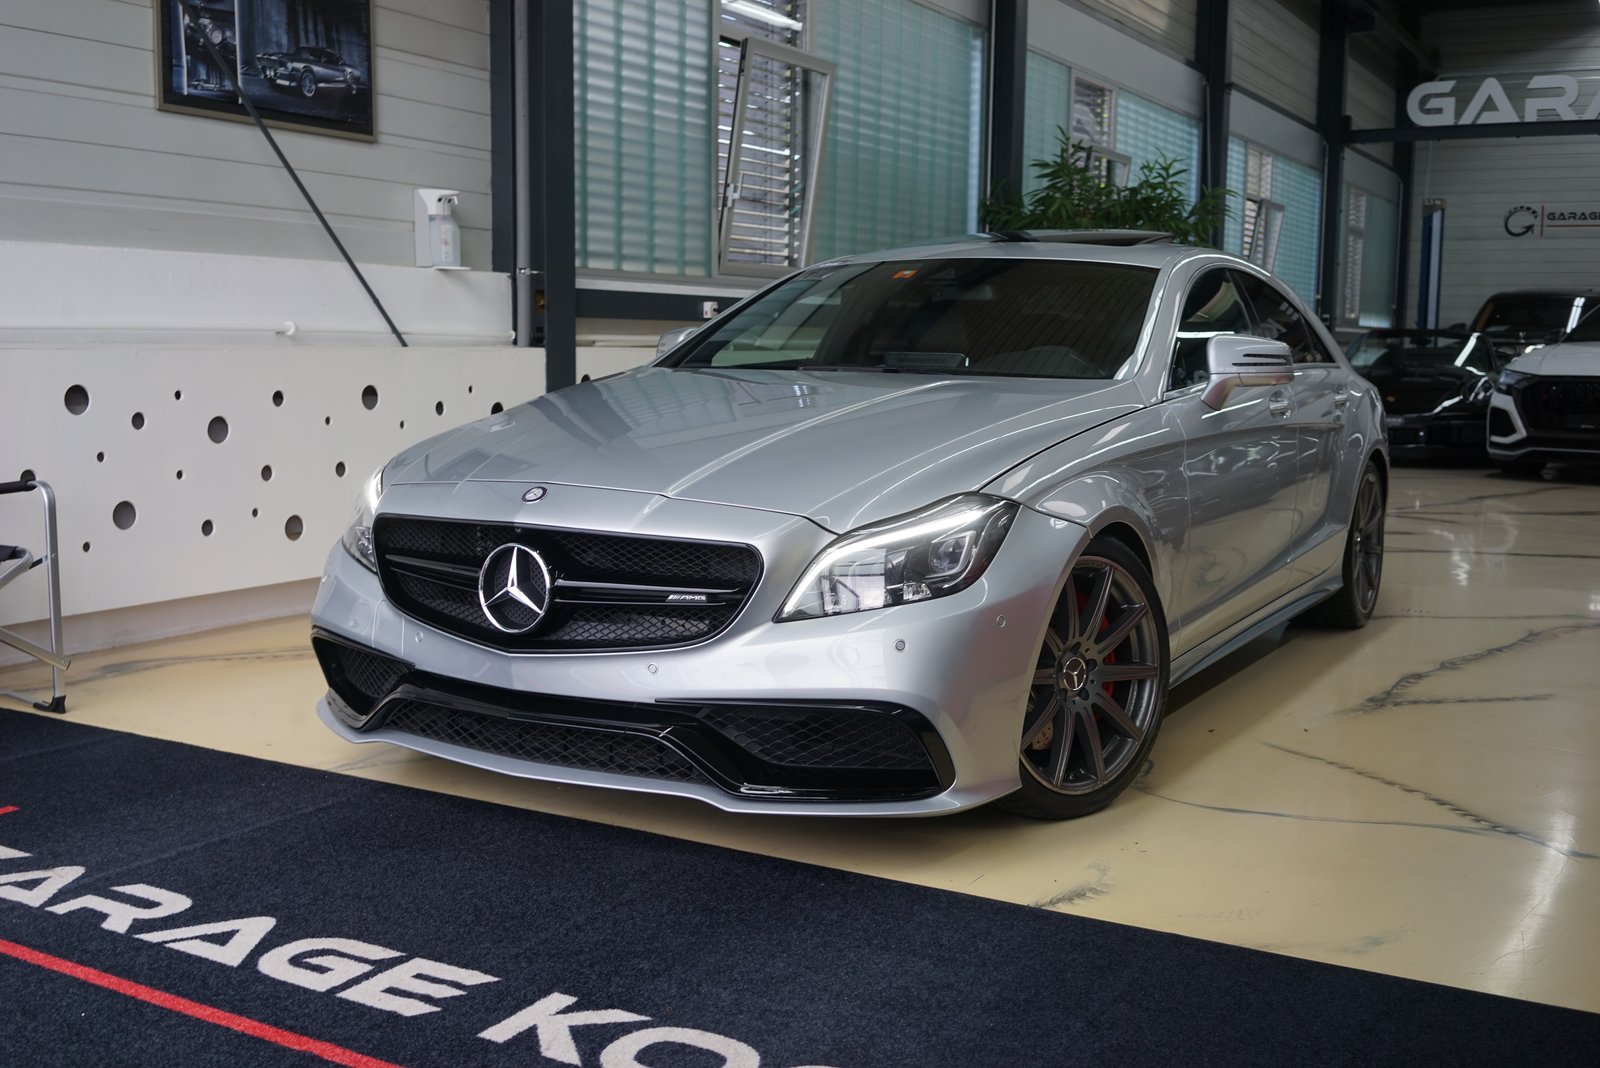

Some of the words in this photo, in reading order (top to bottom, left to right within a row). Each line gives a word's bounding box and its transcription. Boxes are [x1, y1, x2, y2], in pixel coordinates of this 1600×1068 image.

[1406, 74, 1600, 127] GAR
[1547, 211, 1600, 221] GARAG
[0, 845, 499, 1017] ARAGE
[477, 992, 838, 1068] KO
